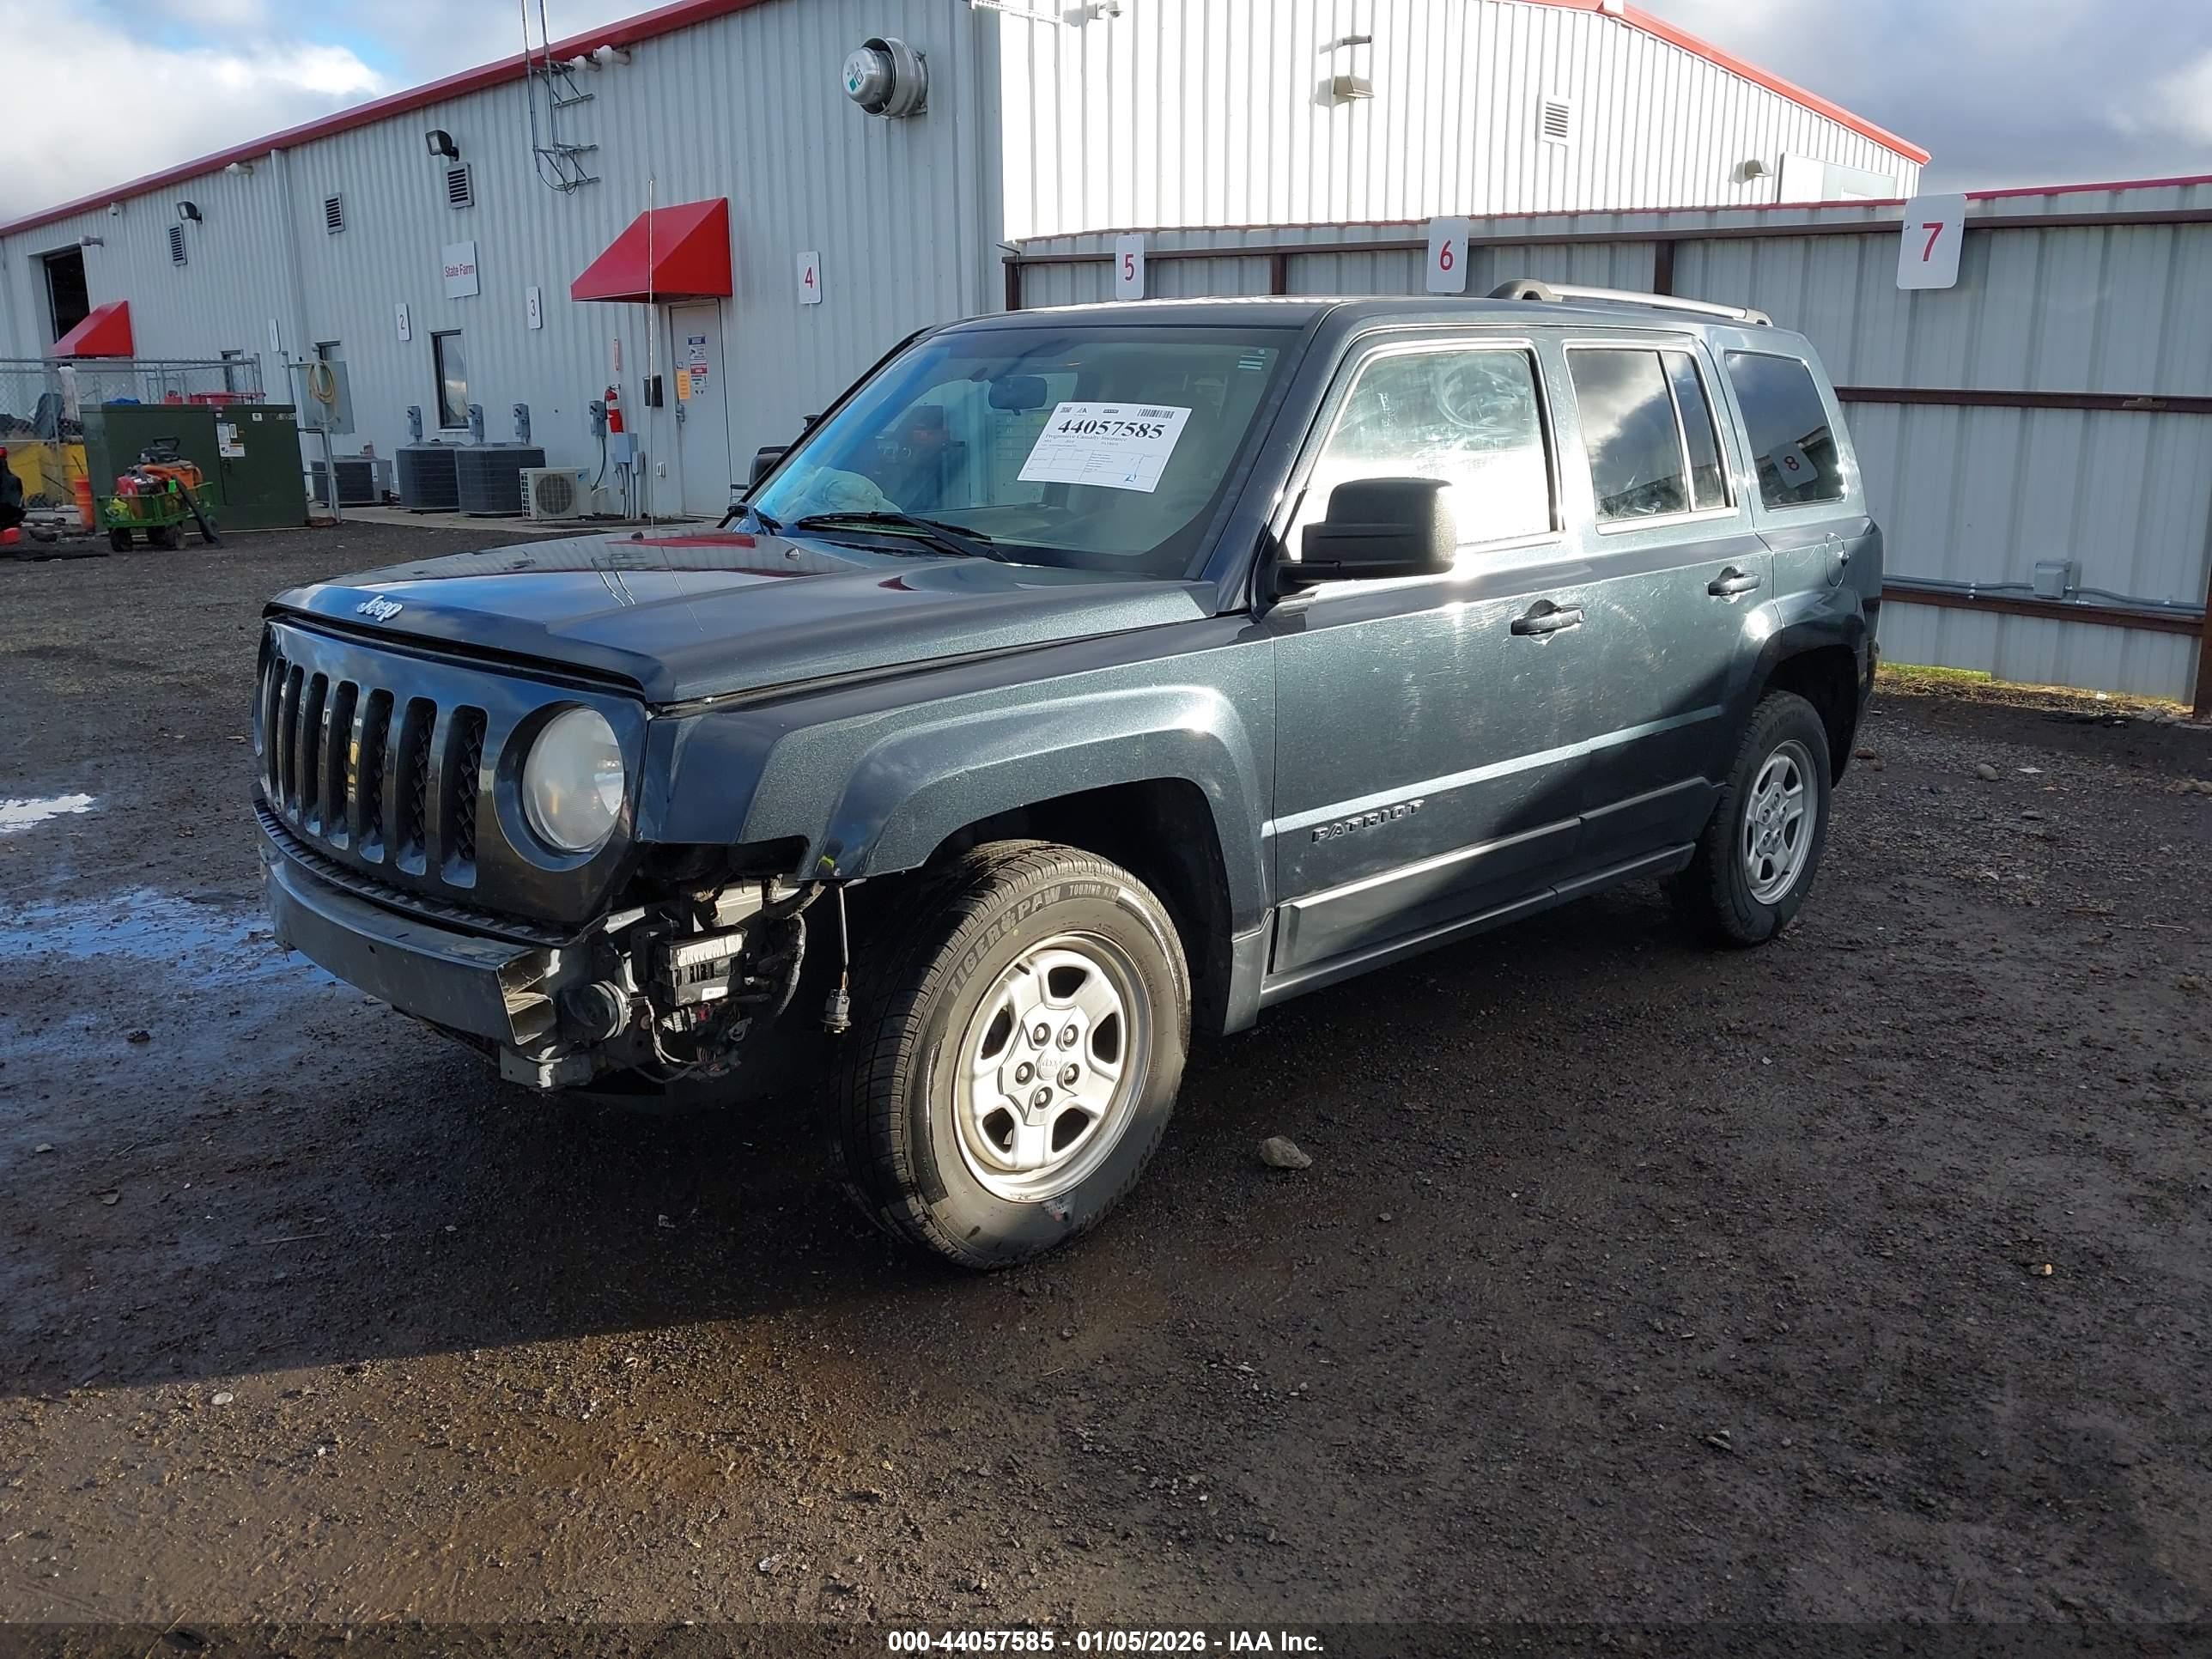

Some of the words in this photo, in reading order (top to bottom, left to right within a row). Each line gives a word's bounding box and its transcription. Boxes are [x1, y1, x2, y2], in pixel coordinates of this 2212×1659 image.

[1440, 240, 1454, 270] 6
[1922, 222, 1944, 262] 7
[445, 265, 459, 277] State
[459, 263, 475, 276] Farm
[805, 266, 813, 289] 4
[1125, 253, 1134, 282] 5
[399, 314, 405, 330] 2
[530, 299, 537, 317] 3
[1057, 419, 1166, 440] 44057585
[356, 594, 404, 623] Jeep
[1311, 799, 1425, 844] PATRIOT
[946, 924, 1001, 997] TIGER
[1018, 885, 1061, 921] PAW
[1069, 884, 1101, 896] TOURING
